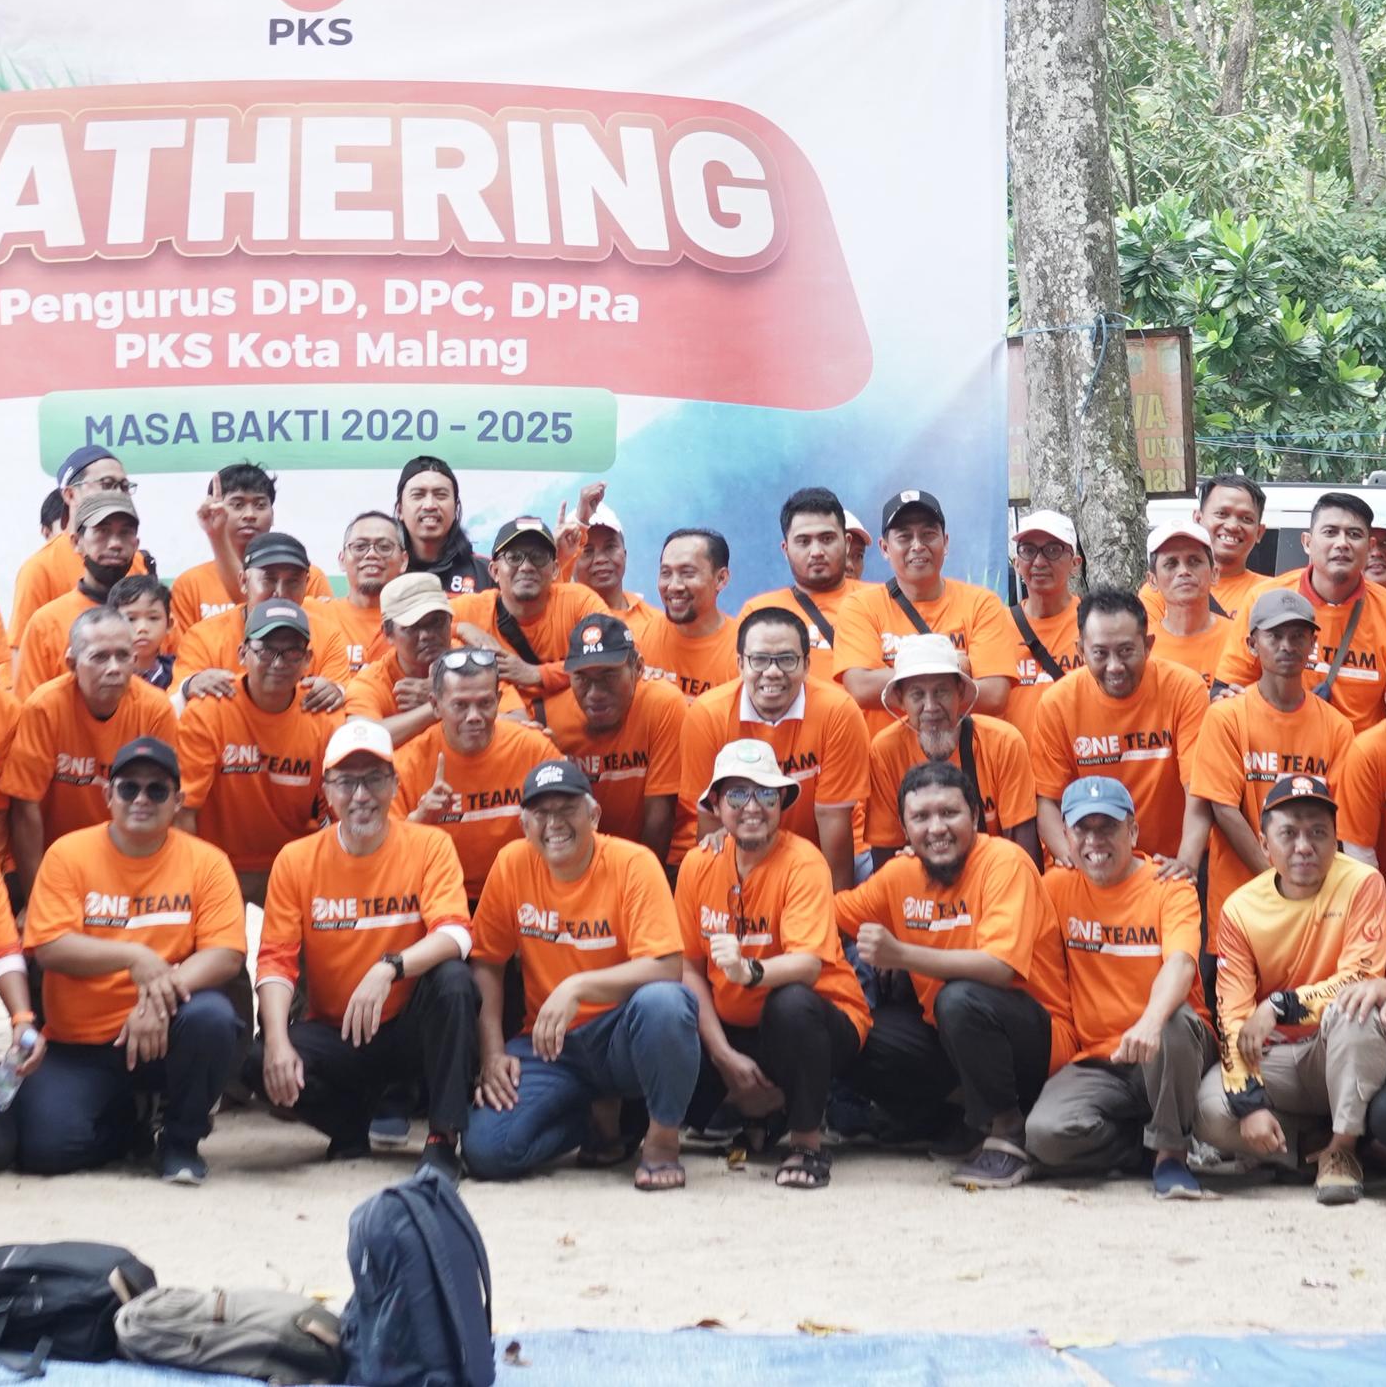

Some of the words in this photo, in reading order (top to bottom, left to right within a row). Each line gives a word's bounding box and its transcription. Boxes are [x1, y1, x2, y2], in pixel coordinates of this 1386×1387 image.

[269, 17, 353, 46] PKS
[252, 278, 368, 319] DPD,
[384, 278, 495, 322] DPC,
[510, 281, 640, 323] DPRa
[115, 332, 213, 369] PKS
[227, 332, 340, 369] Kota
[356, 329, 528, 376] Malang
[85, 411, 200, 447] MASA
[211, 409, 329, 444] BAKTI
[341, 408, 439, 442] 2020
[476, 410, 573, 444] 2025
[583, 643, 604, 655] PKS
[1016, 658, 1038, 678] NE
[680, 676, 712, 696] TEA
[221, 743, 262, 765] ONE
[262, 754, 312, 775] TEAM
[1073, 735, 1121, 758] ONE
[57, 752, 97, 776] ONE
[602, 749, 650, 771] TEAM
[1243, 751, 1278, 772] ONE
[467, 788, 522, 811] TEAM
[84, 891, 130, 917] ONE
[133, 892, 192, 914] TEAM
[312, 897, 358, 921] ONE
[362, 893, 421, 916] TEAM
[903, 896, 935, 920] ONE
[517, 902, 560, 932] ONE
[1068, 916, 1103, 942] ONE
[1101, 925, 1159, 945] TEAM
